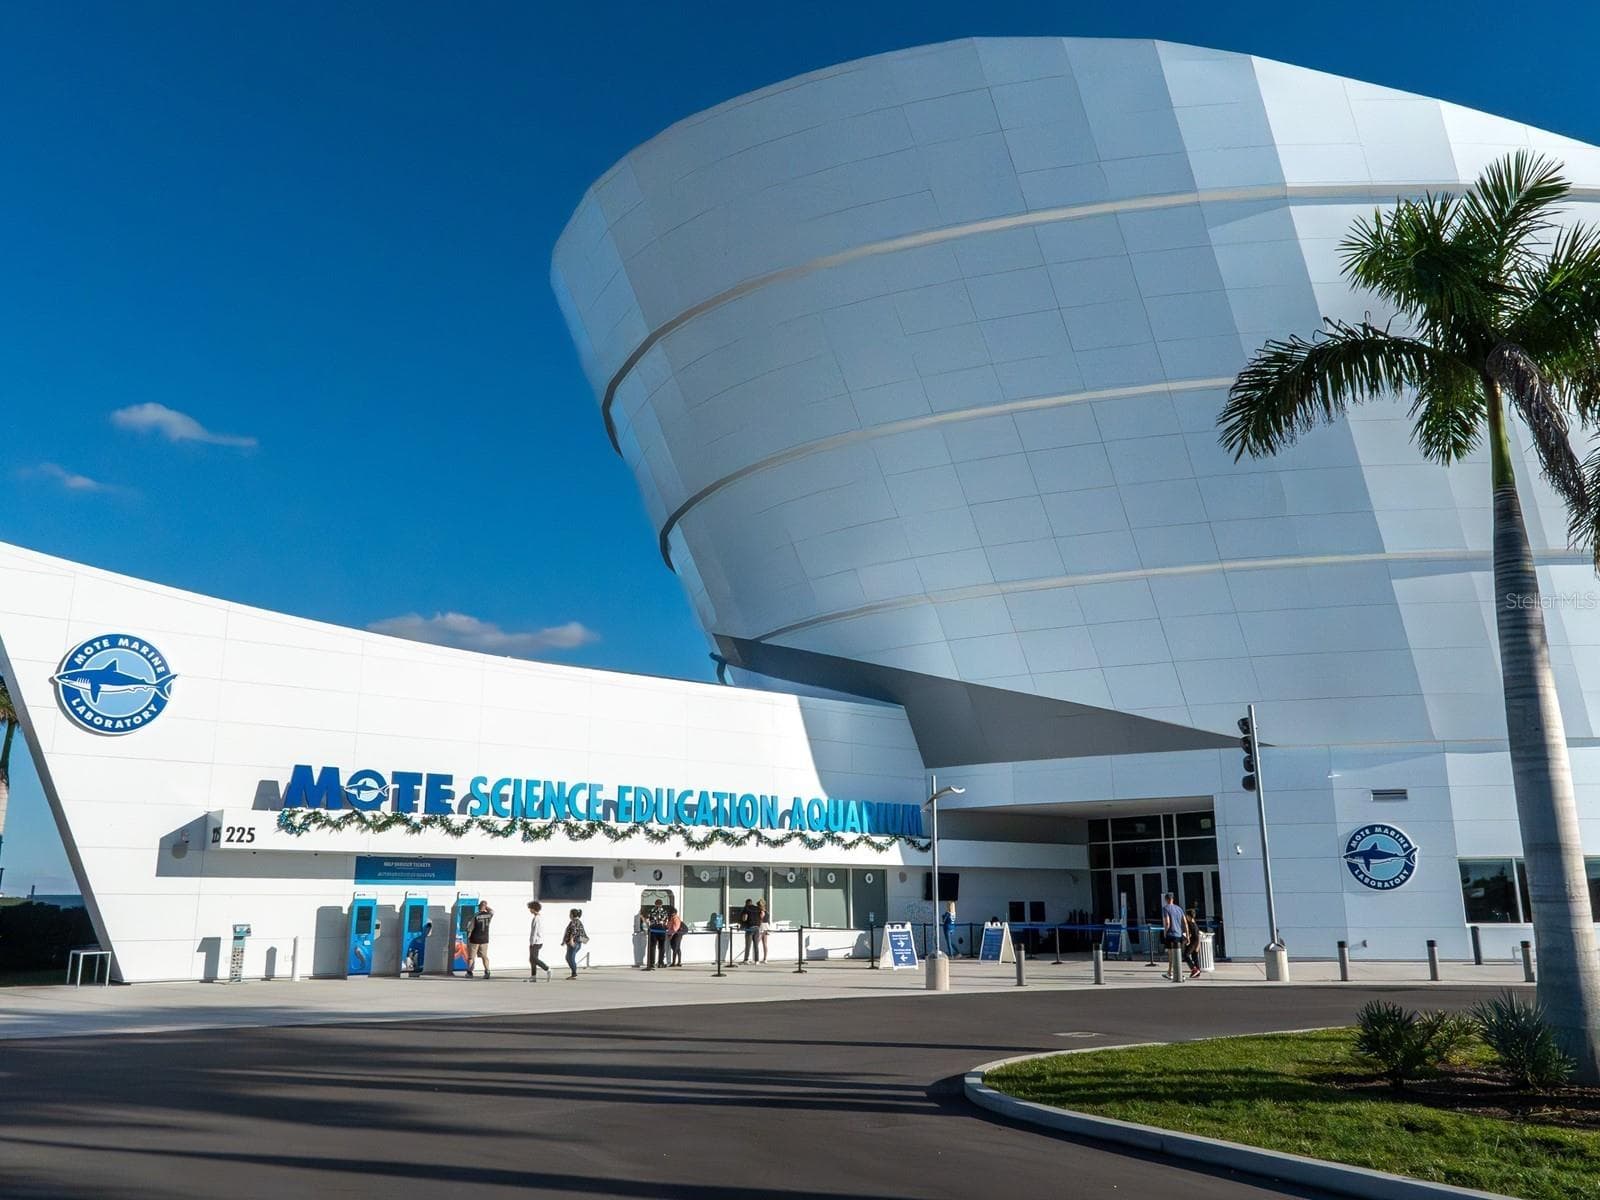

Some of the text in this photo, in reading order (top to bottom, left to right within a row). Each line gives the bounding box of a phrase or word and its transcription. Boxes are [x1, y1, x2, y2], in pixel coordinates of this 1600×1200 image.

[74, 638, 165, 674] MOTE MARINE
[71, 698, 158, 729] LABORATORY
[283, 764, 923, 837] MOTE SCIENCE EDUCATION AQUARIUM
[225, 826, 256, 843] 225
[1350, 826, 1409, 849] MOTE MARINE
[1354, 868, 1409, 889] LABORATORY
